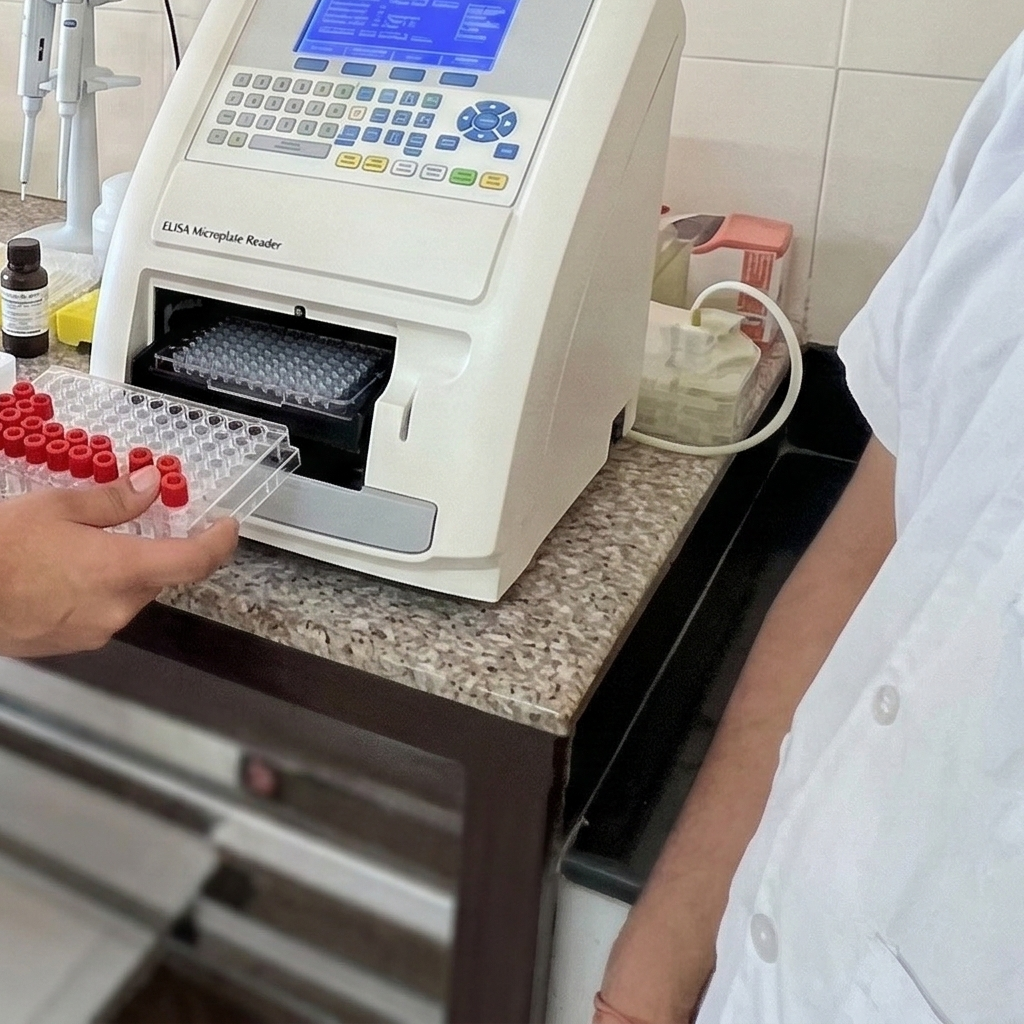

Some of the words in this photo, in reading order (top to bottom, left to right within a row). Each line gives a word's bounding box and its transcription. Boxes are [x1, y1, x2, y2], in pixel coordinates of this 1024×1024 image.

[162, 221, 190, 235] ELISA
[192, 226, 244, 244] Microplate
[245, 234, 283, 251] Reader
